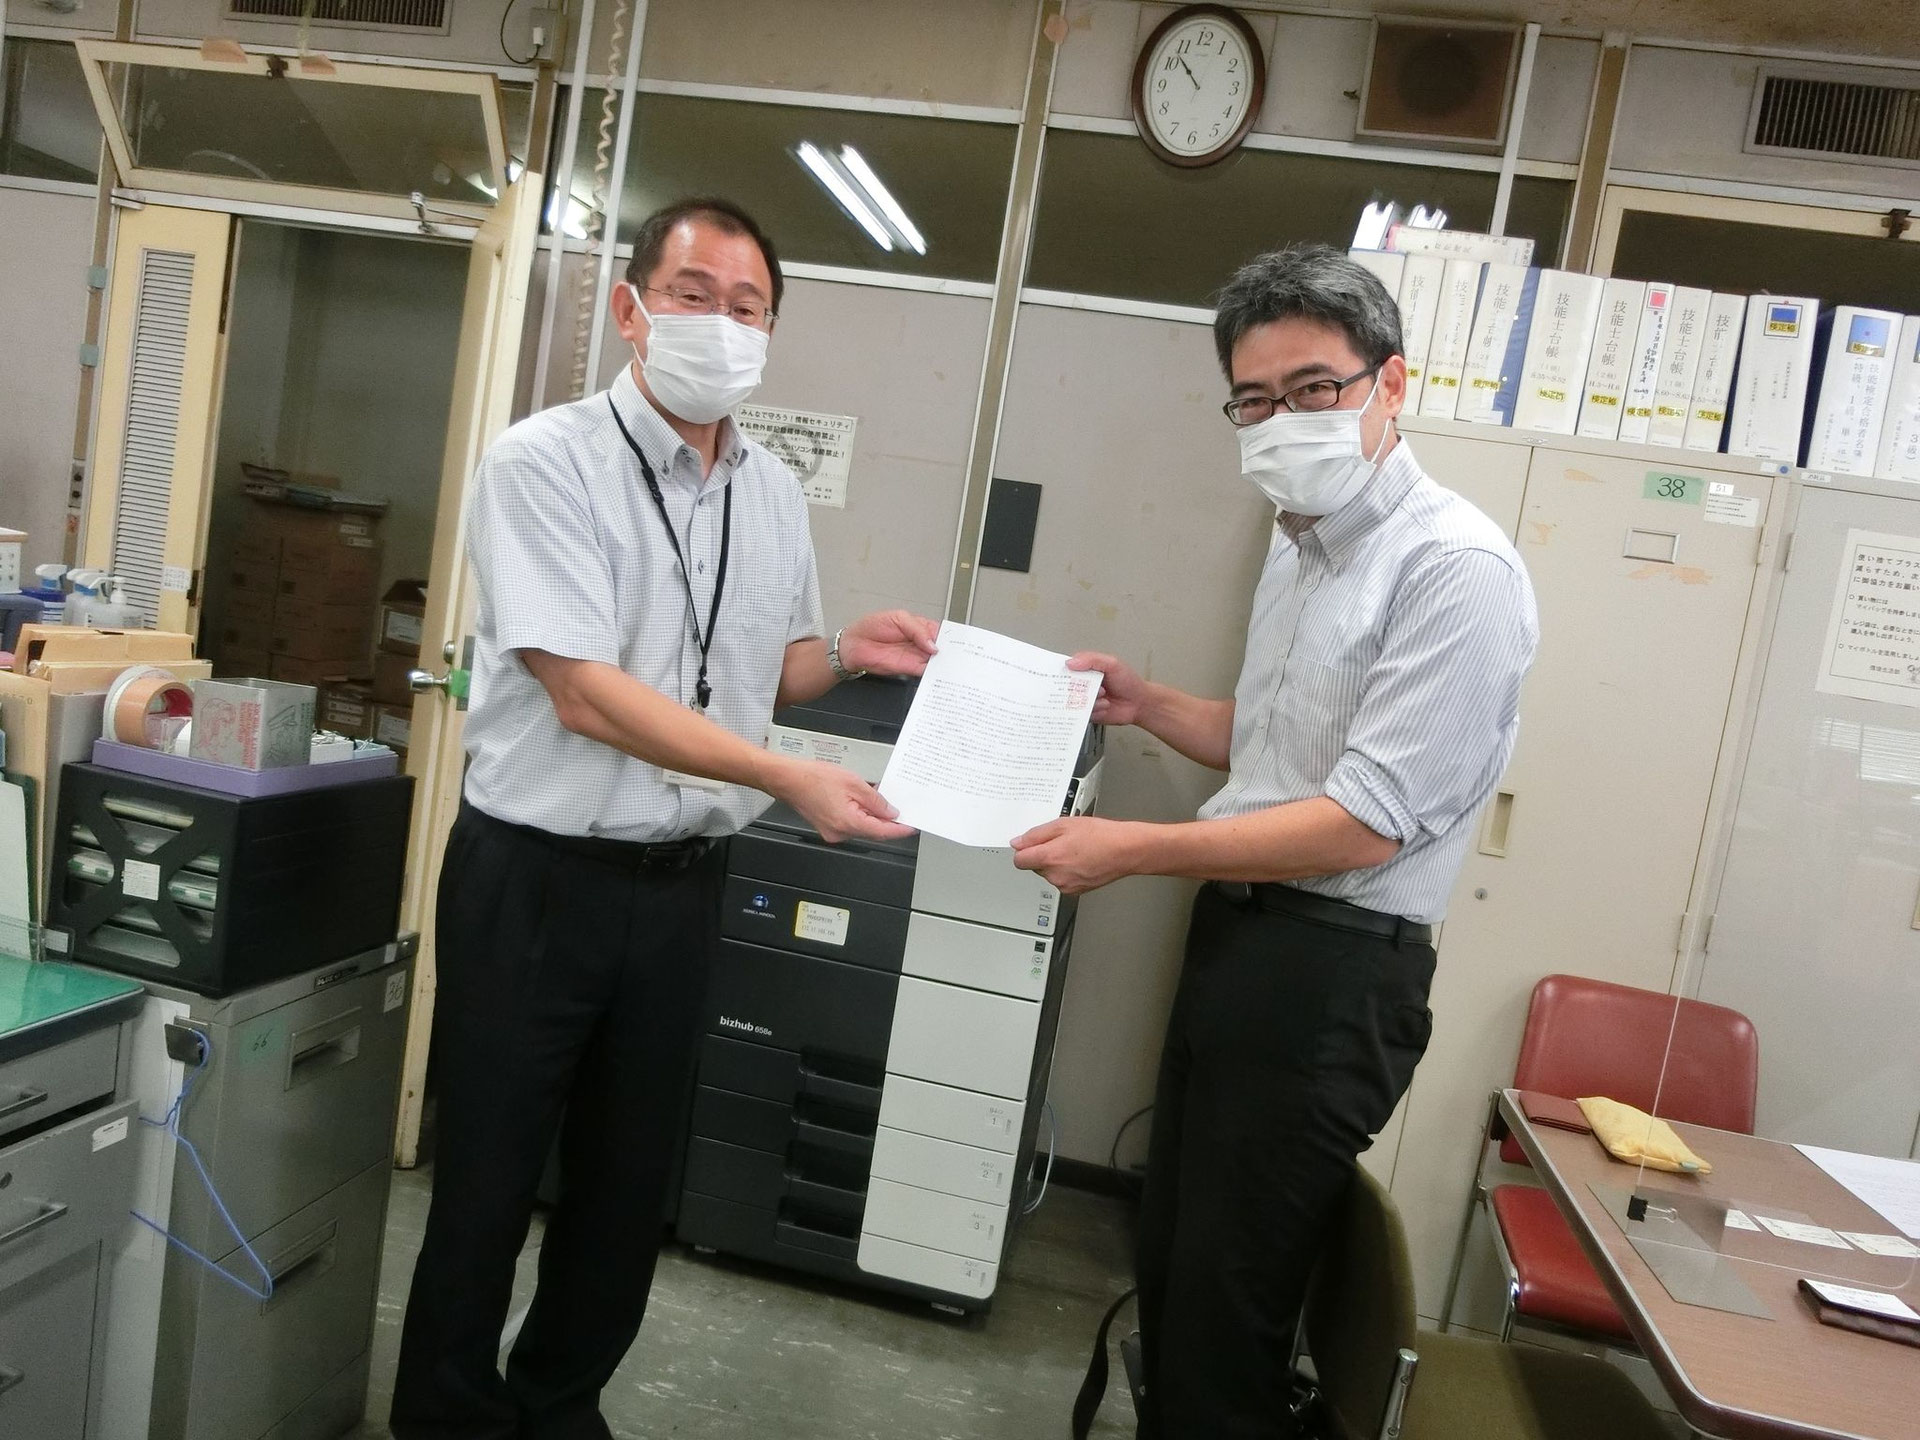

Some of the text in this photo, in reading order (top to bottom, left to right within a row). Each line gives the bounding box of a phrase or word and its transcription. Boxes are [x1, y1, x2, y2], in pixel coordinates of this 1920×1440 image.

[1196, 31, 1213, 46] 12
[1177, 40, 1191, 54] 11
[1218, 41, 1226, 55] 1
[1164, 56, 1179, 70] 10
[1227, 58, 1238, 73] 2
[1157, 79, 1167, 93] 9
[1229, 81, 1240, 96] 3
[1159, 101, 1169, 115] 8
[1222, 105, 1232, 118] 4
[1170, 122, 1179, 135] 7
[1209, 123, 1221, 137] 5
[1187, 131, 1197, 145] 6
[1545, 292, 1570, 358] 技能士台帳
[1601, 300, 1628, 366] 技能士台帳
[1670, 308, 1696, 375] 技能士台帳
[1657, 477, 1686, 498] 38
[719, 1016, 772, 1036] bizhub 658e
